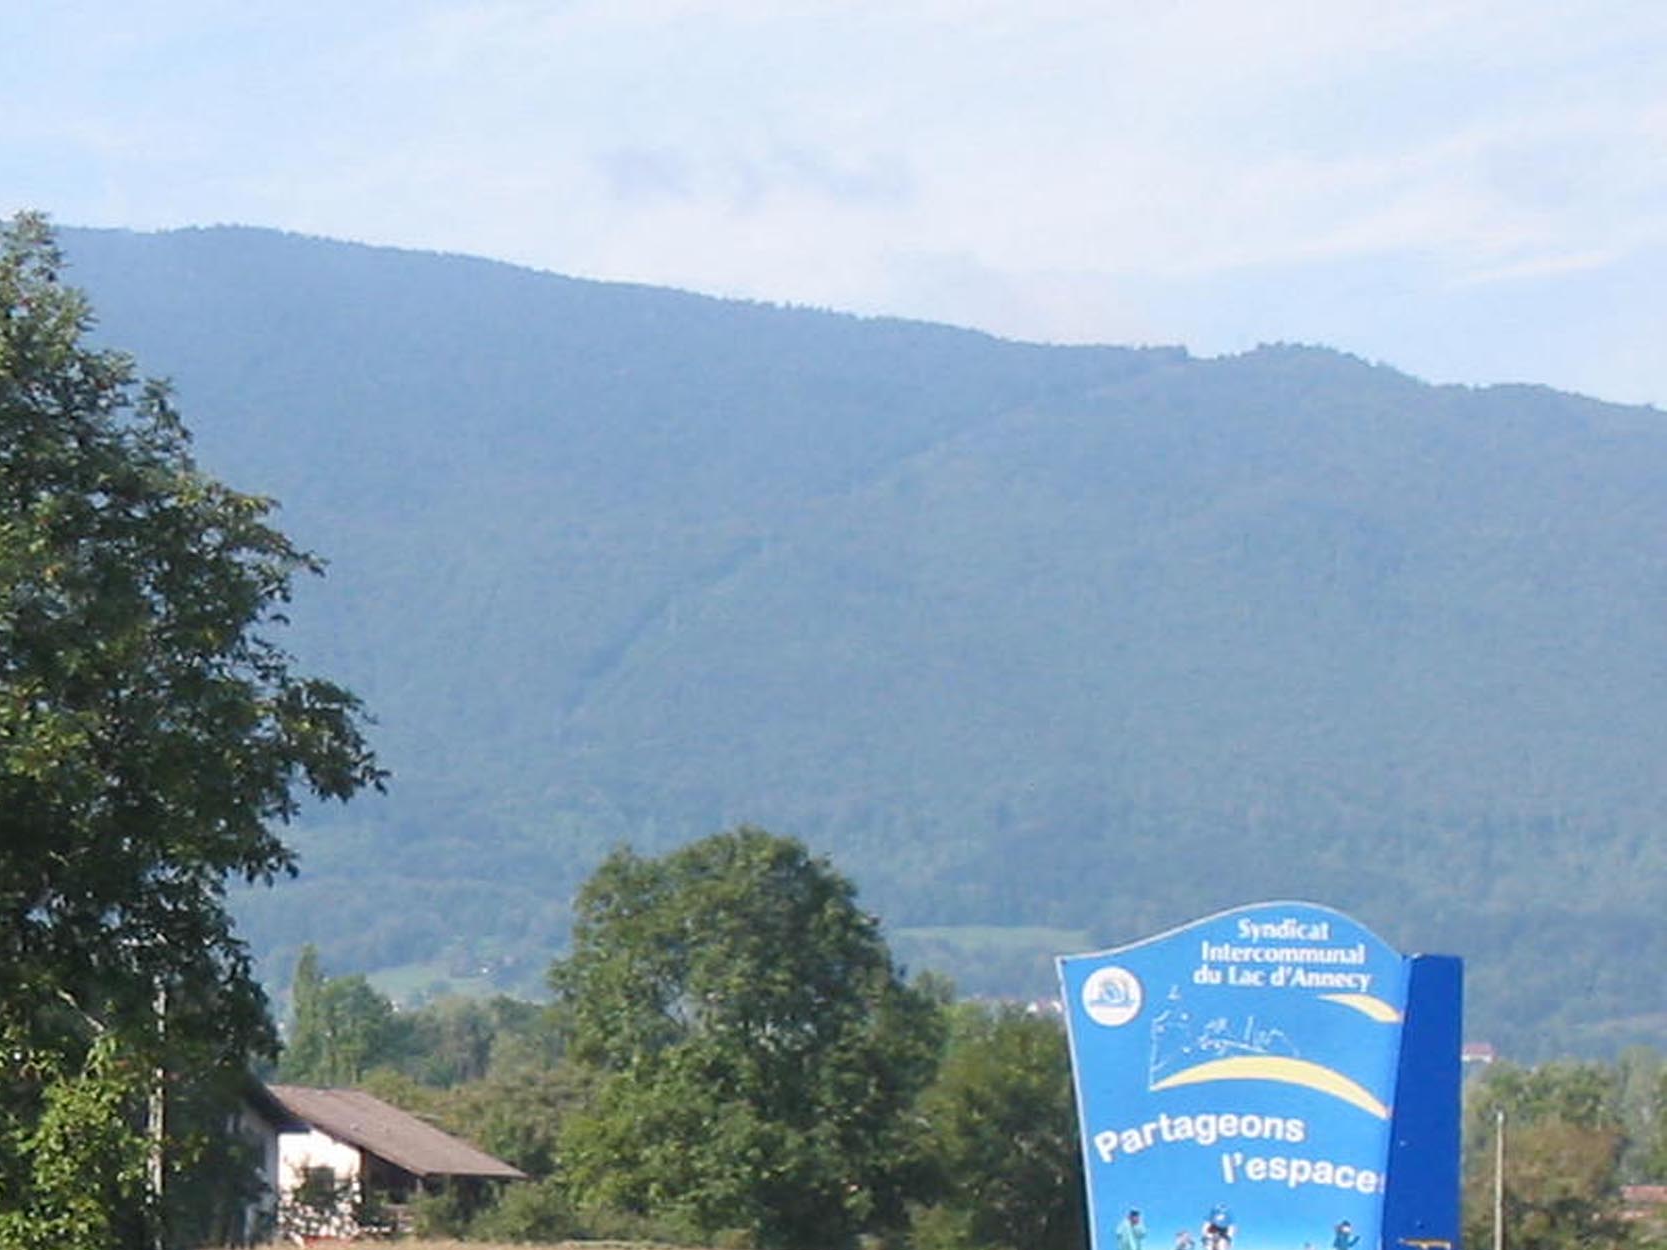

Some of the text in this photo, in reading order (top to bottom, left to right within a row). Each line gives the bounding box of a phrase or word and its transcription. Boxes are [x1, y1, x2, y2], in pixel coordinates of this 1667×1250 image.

[1237, 917, 1330, 943] Syndicat
[1201, 940, 1366, 965] Intercommunal
[1193, 963, 1371, 993] du Lac d'Annecy
[1093, 1112, 1306, 1164] Partageons
